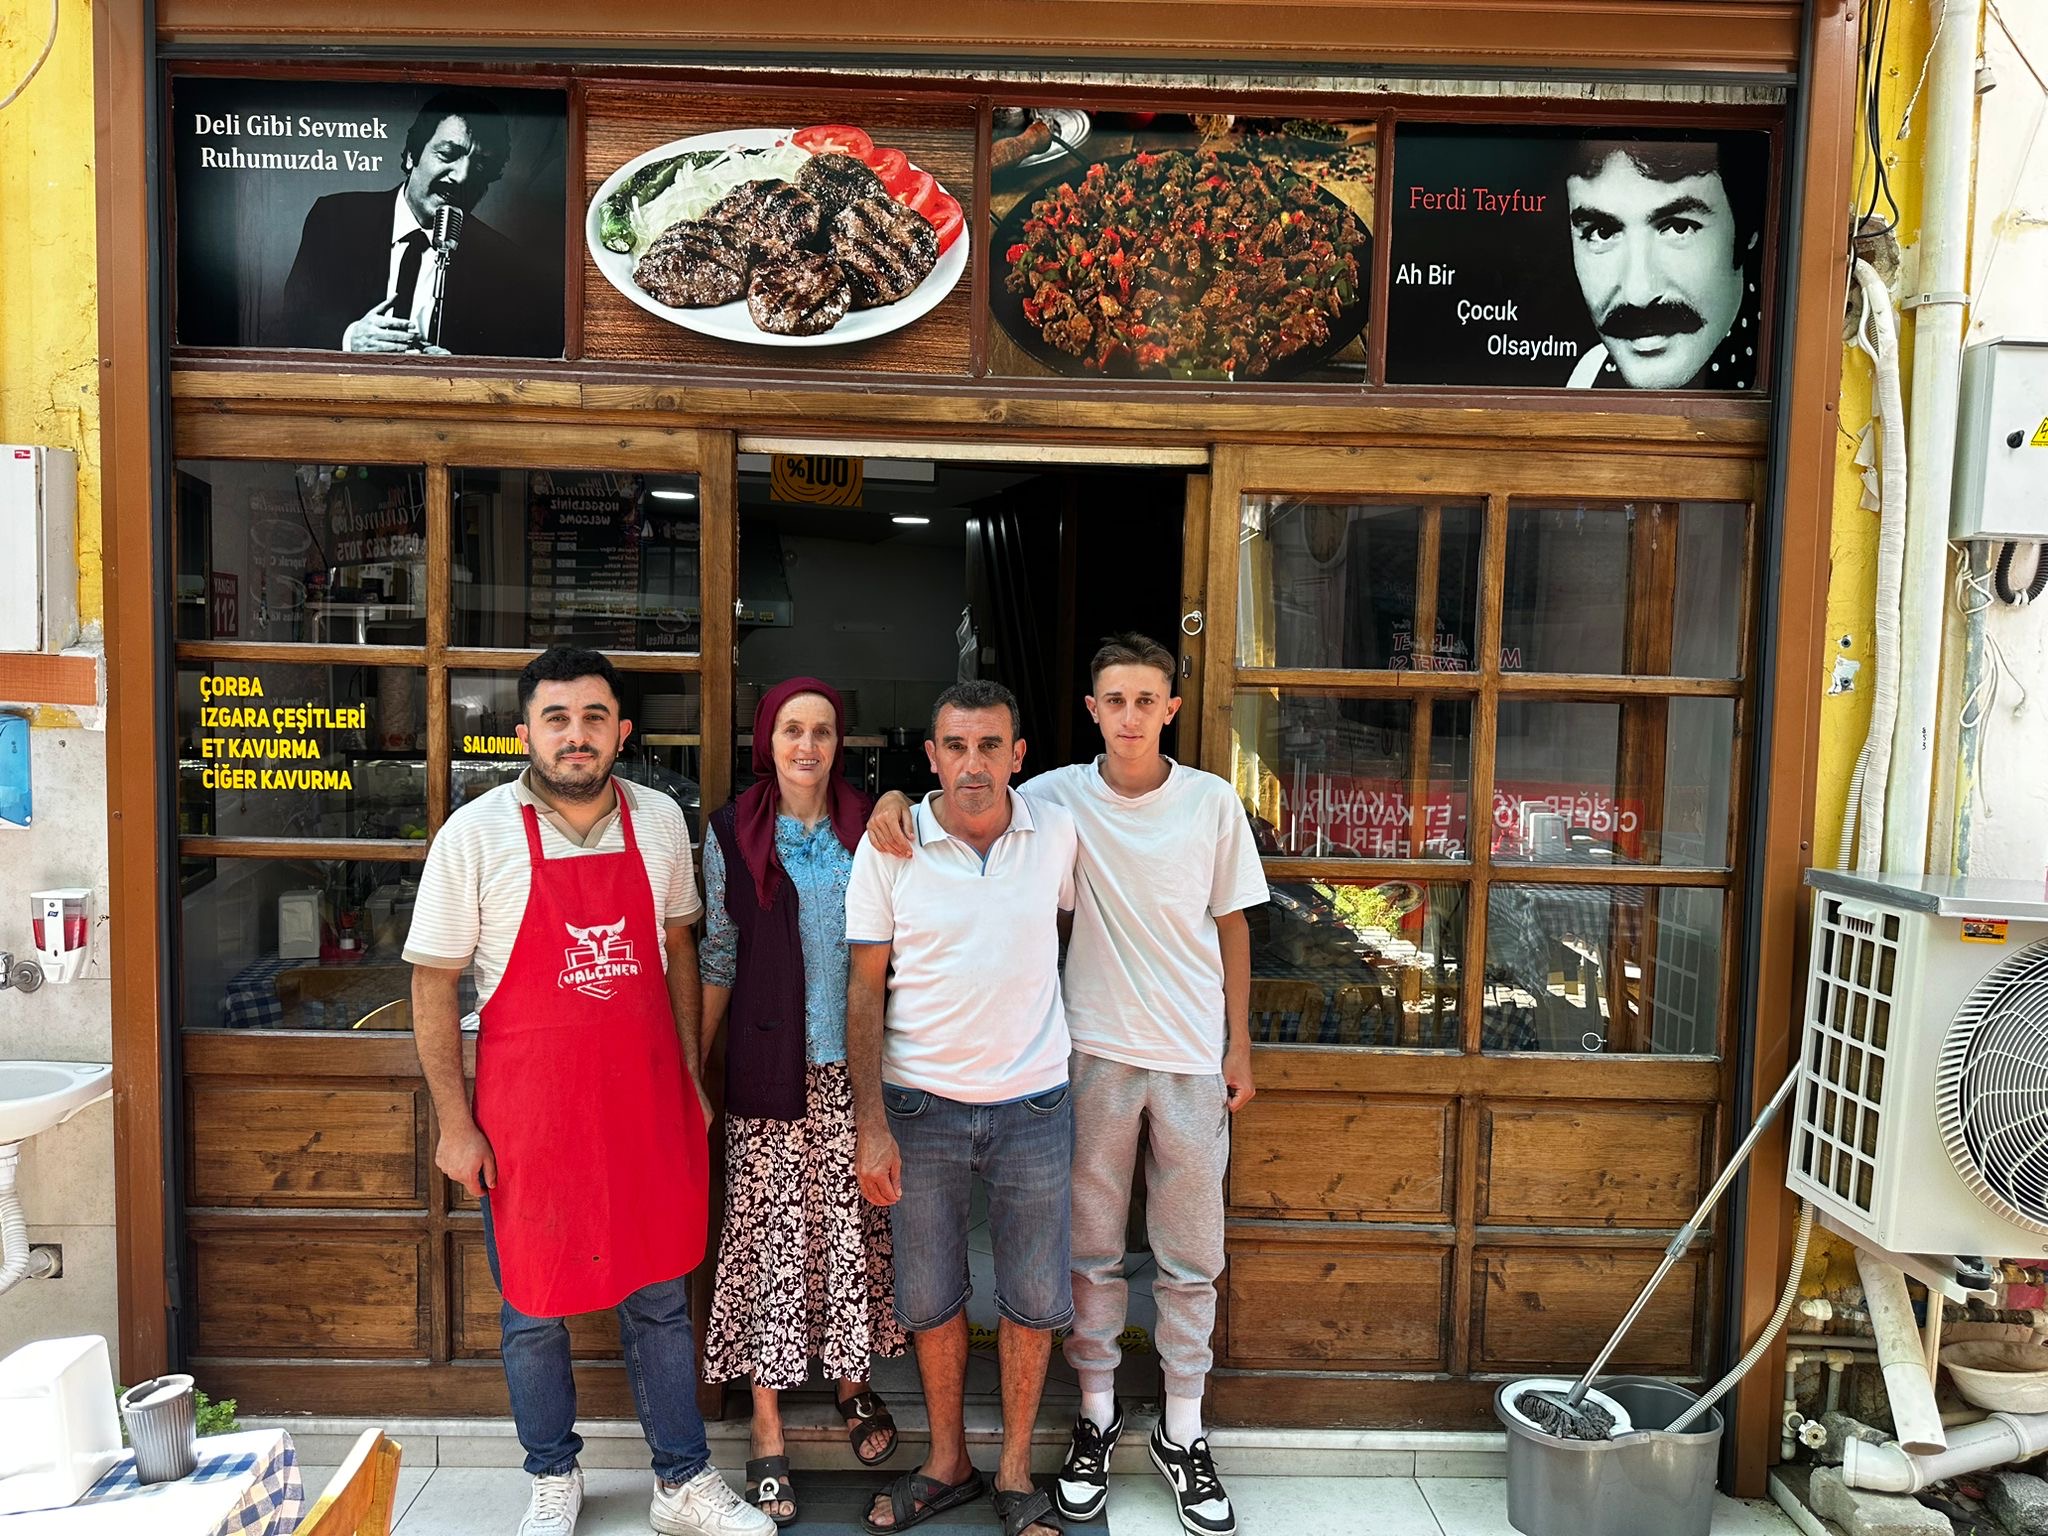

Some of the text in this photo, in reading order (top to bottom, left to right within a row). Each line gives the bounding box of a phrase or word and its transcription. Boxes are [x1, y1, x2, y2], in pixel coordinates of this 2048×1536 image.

[194, 114, 389, 139] Deli Gibi Sevmek
[201, 146, 384, 172] Ruhumuzda Var
[1409, 186, 1547, 216] Ferdi Tayfur
[1395, 263, 1456, 286] Ah Bir
[1456, 299, 1518, 325] Çocuk
[1486, 333, 1578, 361] Olsaydım
[786, 456, 849, 488] %100
[213, 597, 236, 632] 112
[199, 675, 264, 703] ÇORBA
[200, 702, 366, 736] IZGARA ÇEŞİTLERİ
[201, 737, 321, 761] ET KAVURMA
[201, 764, 353, 791] CİĞER KAVURMA
